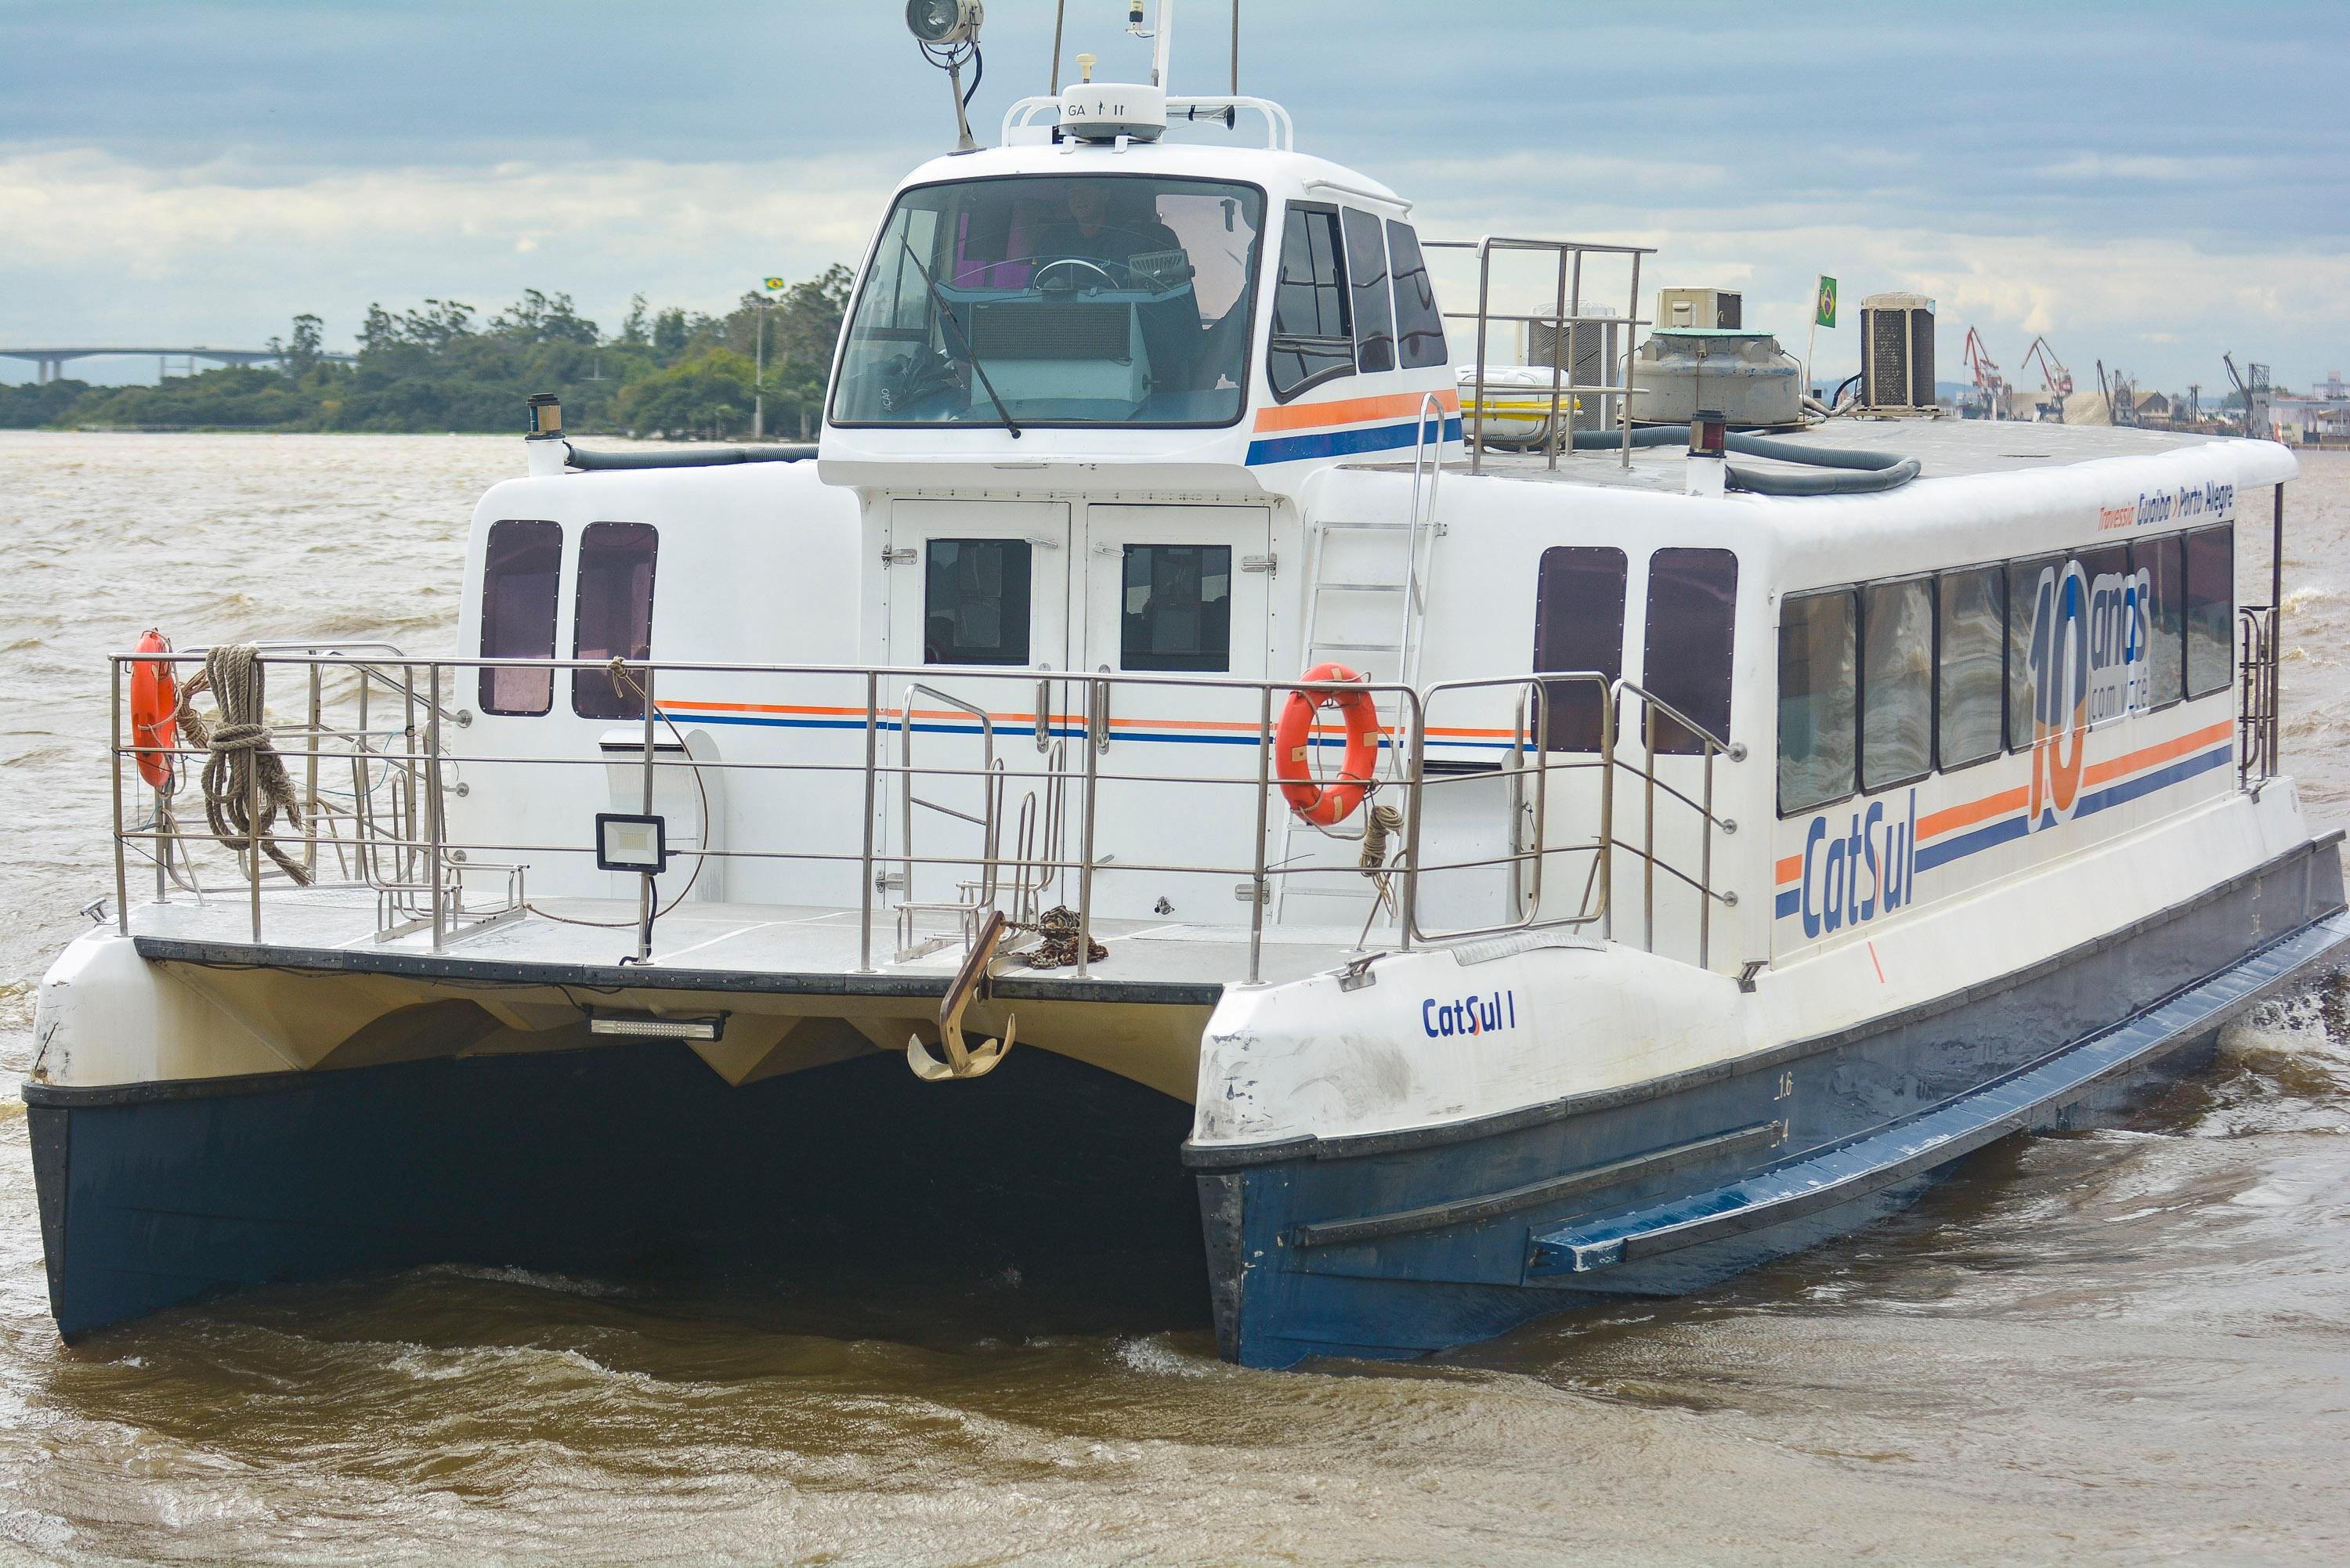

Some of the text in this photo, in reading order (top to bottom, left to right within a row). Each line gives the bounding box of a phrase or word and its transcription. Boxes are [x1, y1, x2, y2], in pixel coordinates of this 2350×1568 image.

[2178, 486, 2202, 518] Porto
[2205, 479, 2233, 518] Alegre
[2030, 573, 2148, 821] 10 anos
[2092, 685, 2115, 720] com
[1802, 788, 1916, 938] CatSul
[1422, 991, 1502, 1039] CatSul
